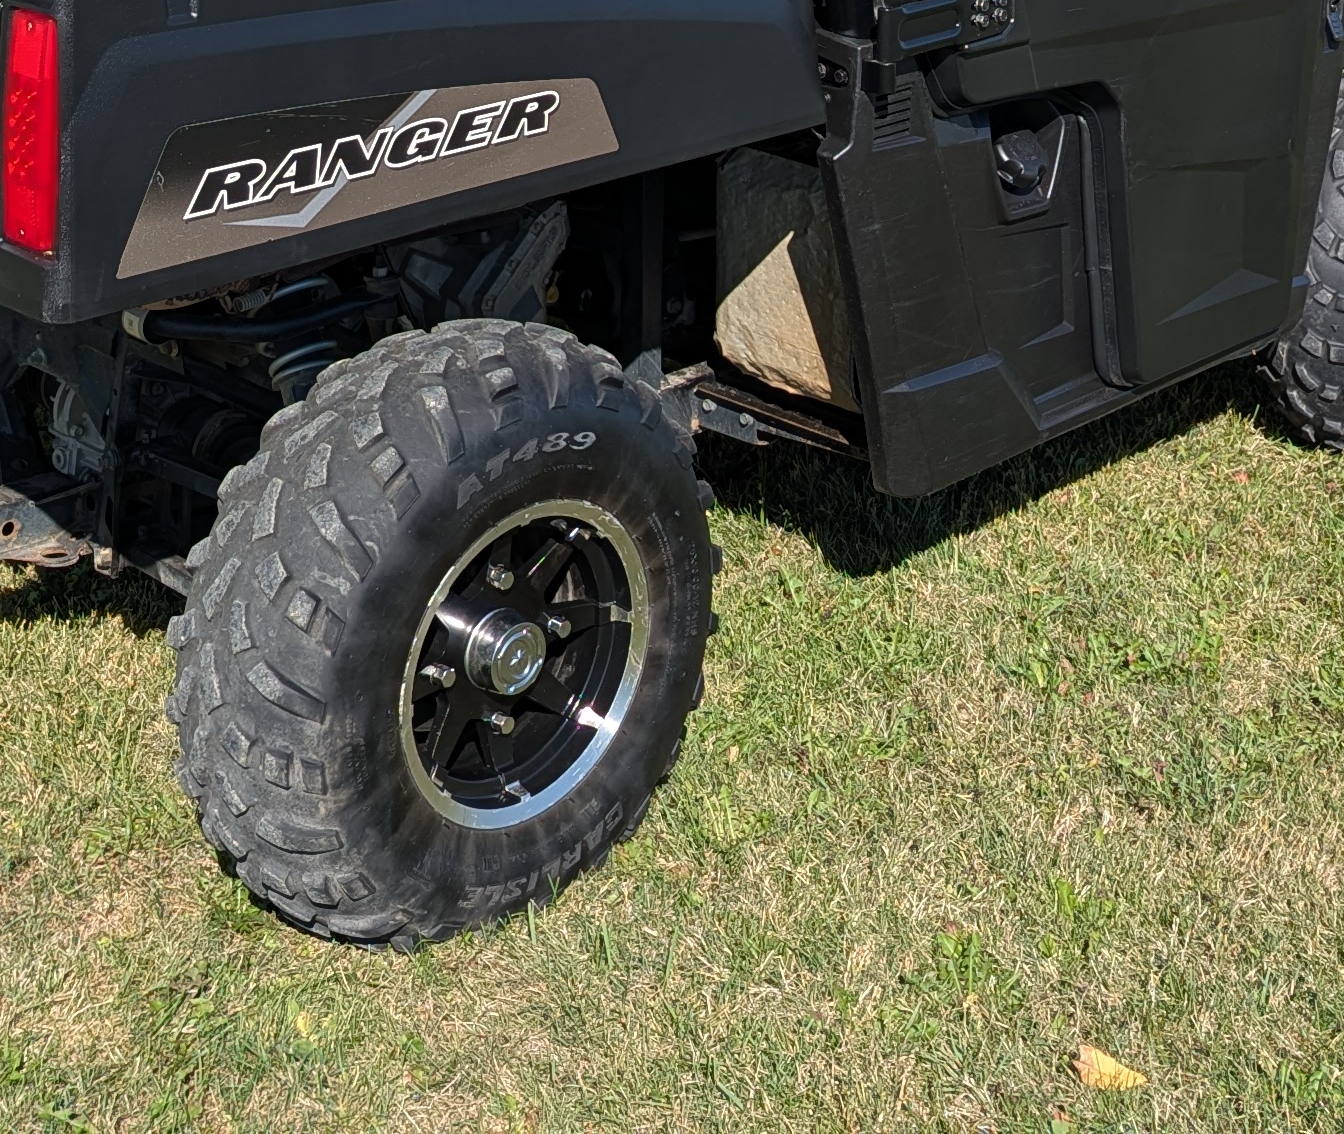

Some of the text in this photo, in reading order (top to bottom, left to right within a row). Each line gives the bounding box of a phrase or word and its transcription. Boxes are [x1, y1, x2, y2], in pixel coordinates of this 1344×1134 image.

[183, 90, 561, 222] RANGER
[457, 431, 597, 510] AT489
[458, 801, 623, 908] CARLISLE
